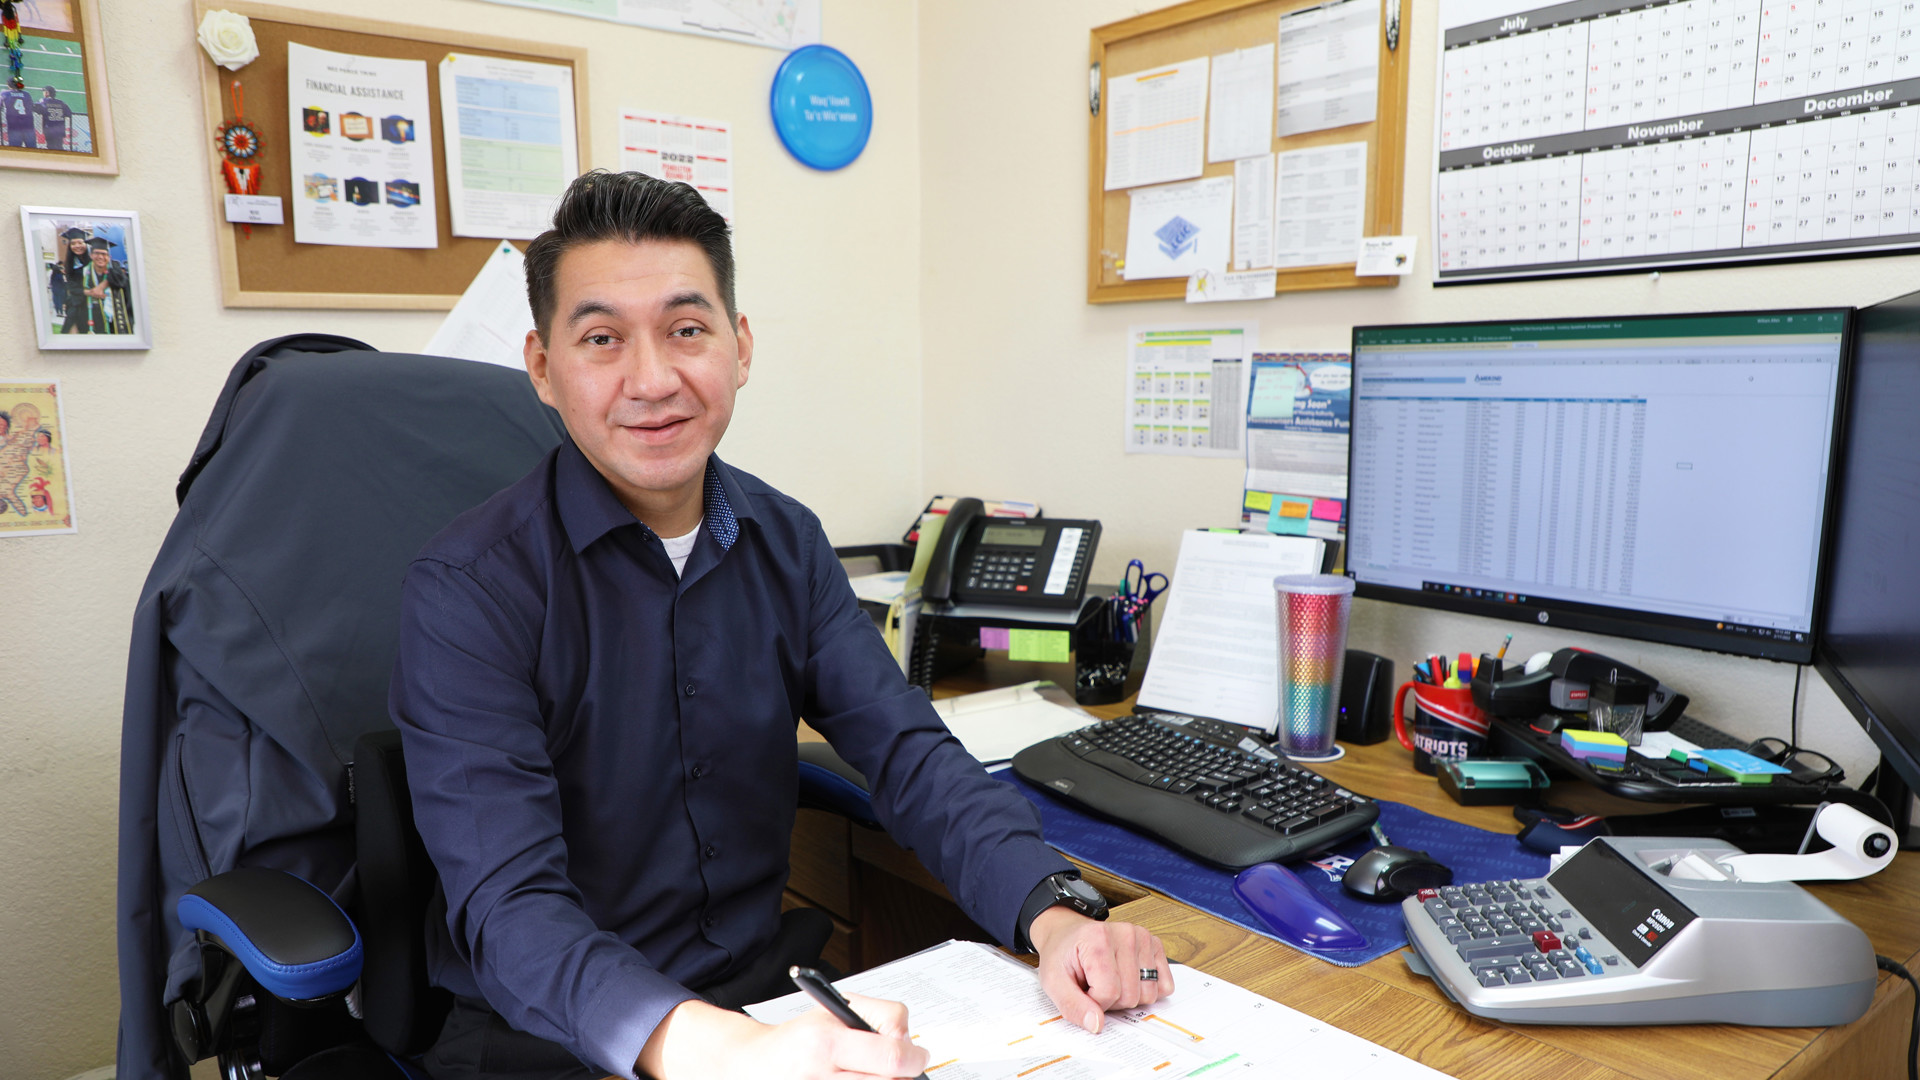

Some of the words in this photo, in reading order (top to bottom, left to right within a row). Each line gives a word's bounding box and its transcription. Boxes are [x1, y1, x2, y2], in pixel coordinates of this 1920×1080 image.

[1500, 16, 1528, 31] July
[305, 79, 347, 96] FINANCIAL
[350, 86, 404, 100] ASSISTANCE
[14, 99, 26, 115] 4
[1804, 89, 1893, 113] December
[1628, 120, 1704, 140] November
[661, 152, 694, 163] 2022
[1483, 144, 1535, 159] October
[1407, 839, 1487, 853] PATRIOTS
[1452, 855, 1536, 874] PATRIOTS
[1652, 908, 1675, 929] Canon
